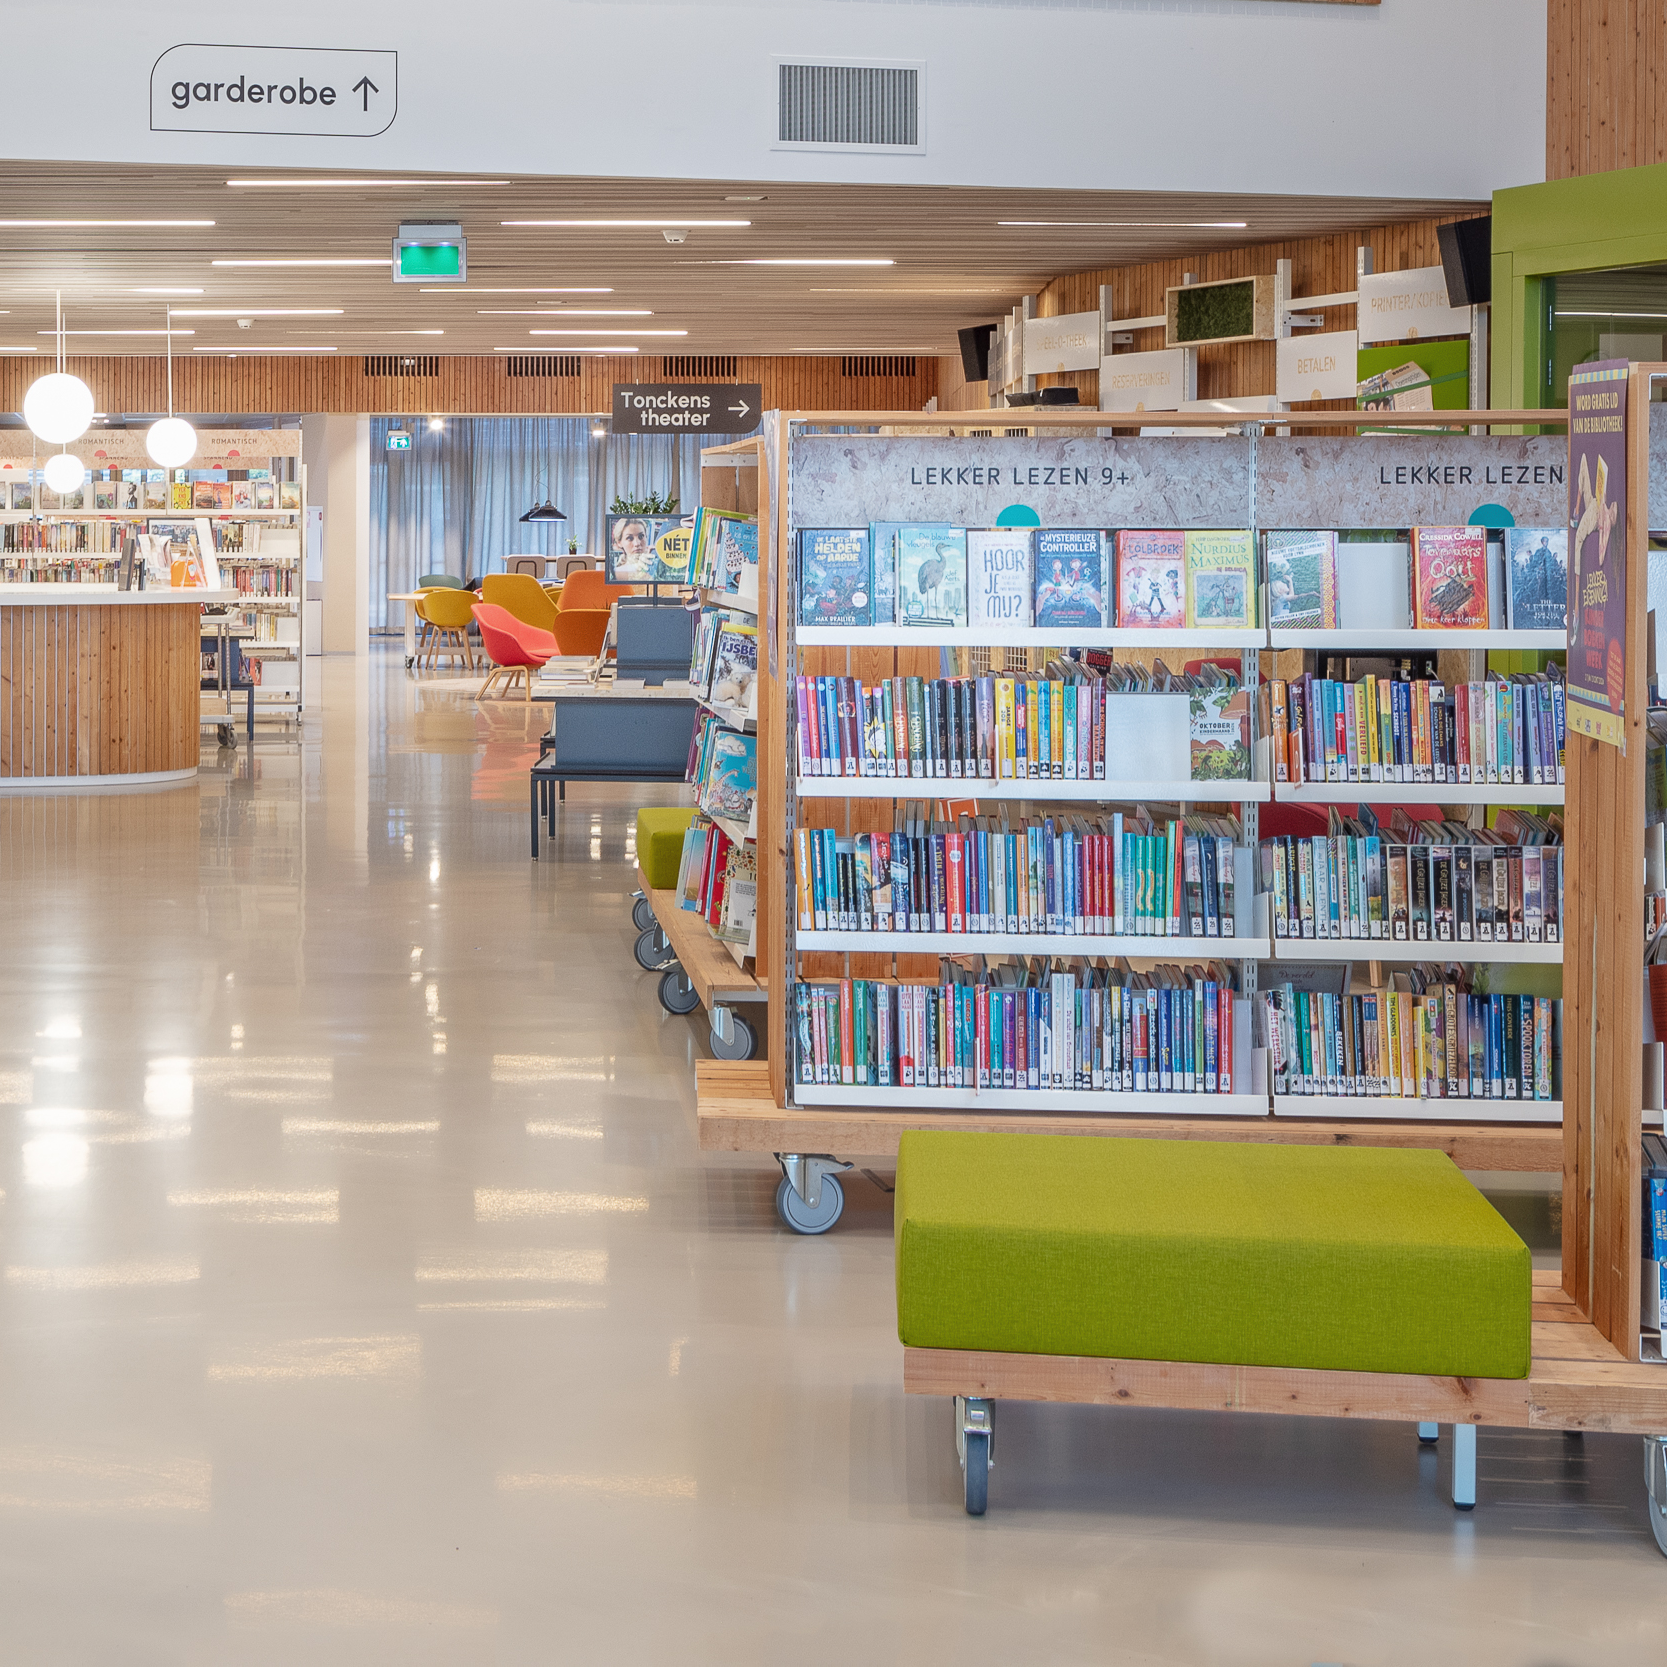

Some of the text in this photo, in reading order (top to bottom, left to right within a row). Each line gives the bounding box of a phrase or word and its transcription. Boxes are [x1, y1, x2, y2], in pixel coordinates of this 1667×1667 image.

[171, 75, 337, 109] garderobe
[1297, 355, 1336, 374] BETALEN
[620, 391, 711, 408] Tonckens
[1576, 392, 1619, 411] WORD GRATIS LID
[640, 409, 711, 426] theater
[1572, 418, 1584, 434] VAN
[1584, 417, 1590, 433] DE
[911, 467, 1130, 486] LEKKER LEZEN 9+
[1380, 465, 1564, 485] LEKKER LEZEN
[663, 535, 689, 551] NÉT
[907, 539, 935, 549] vleugels
[919, 532, 956, 541] De blauwe
[1045, 534, 1096, 542] MYSTERIEUZE
[1419, 532, 1483, 541] CRESSIDA COWELL
[814, 543, 861, 554] HELDEN
[1040, 541, 1097, 552] CONTROLLER
[1191, 543, 1246, 555] NURDIUS
[827, 553, 859, 562] AARDE
[983, 548, 1025, 573] HOOR
[1190, 554, 1250, 569] MAXIMUS
[984, 573, 999, 594] JE
[1440, 616, 1455, 624] keer
[1457, 616, 1485, 625] kloppen
[721, 642, 757, 657] IJSBE
[1586, 649, 1603, 670] WEEK
[1359, 720, 1367, 755] VERLIEFD
[1416, 860, 1427, 908] DE GRIJZE JAGER
[1439, 861, 1449, 909] DE GRIJZE JAGER
[1270, 1011, 1281, 1065] HET WERKSTUK
[1336, 1030, 1344, 1066] BEKEKEN
[1522, 1019, 1533, 1076] SPOOKTOREN
